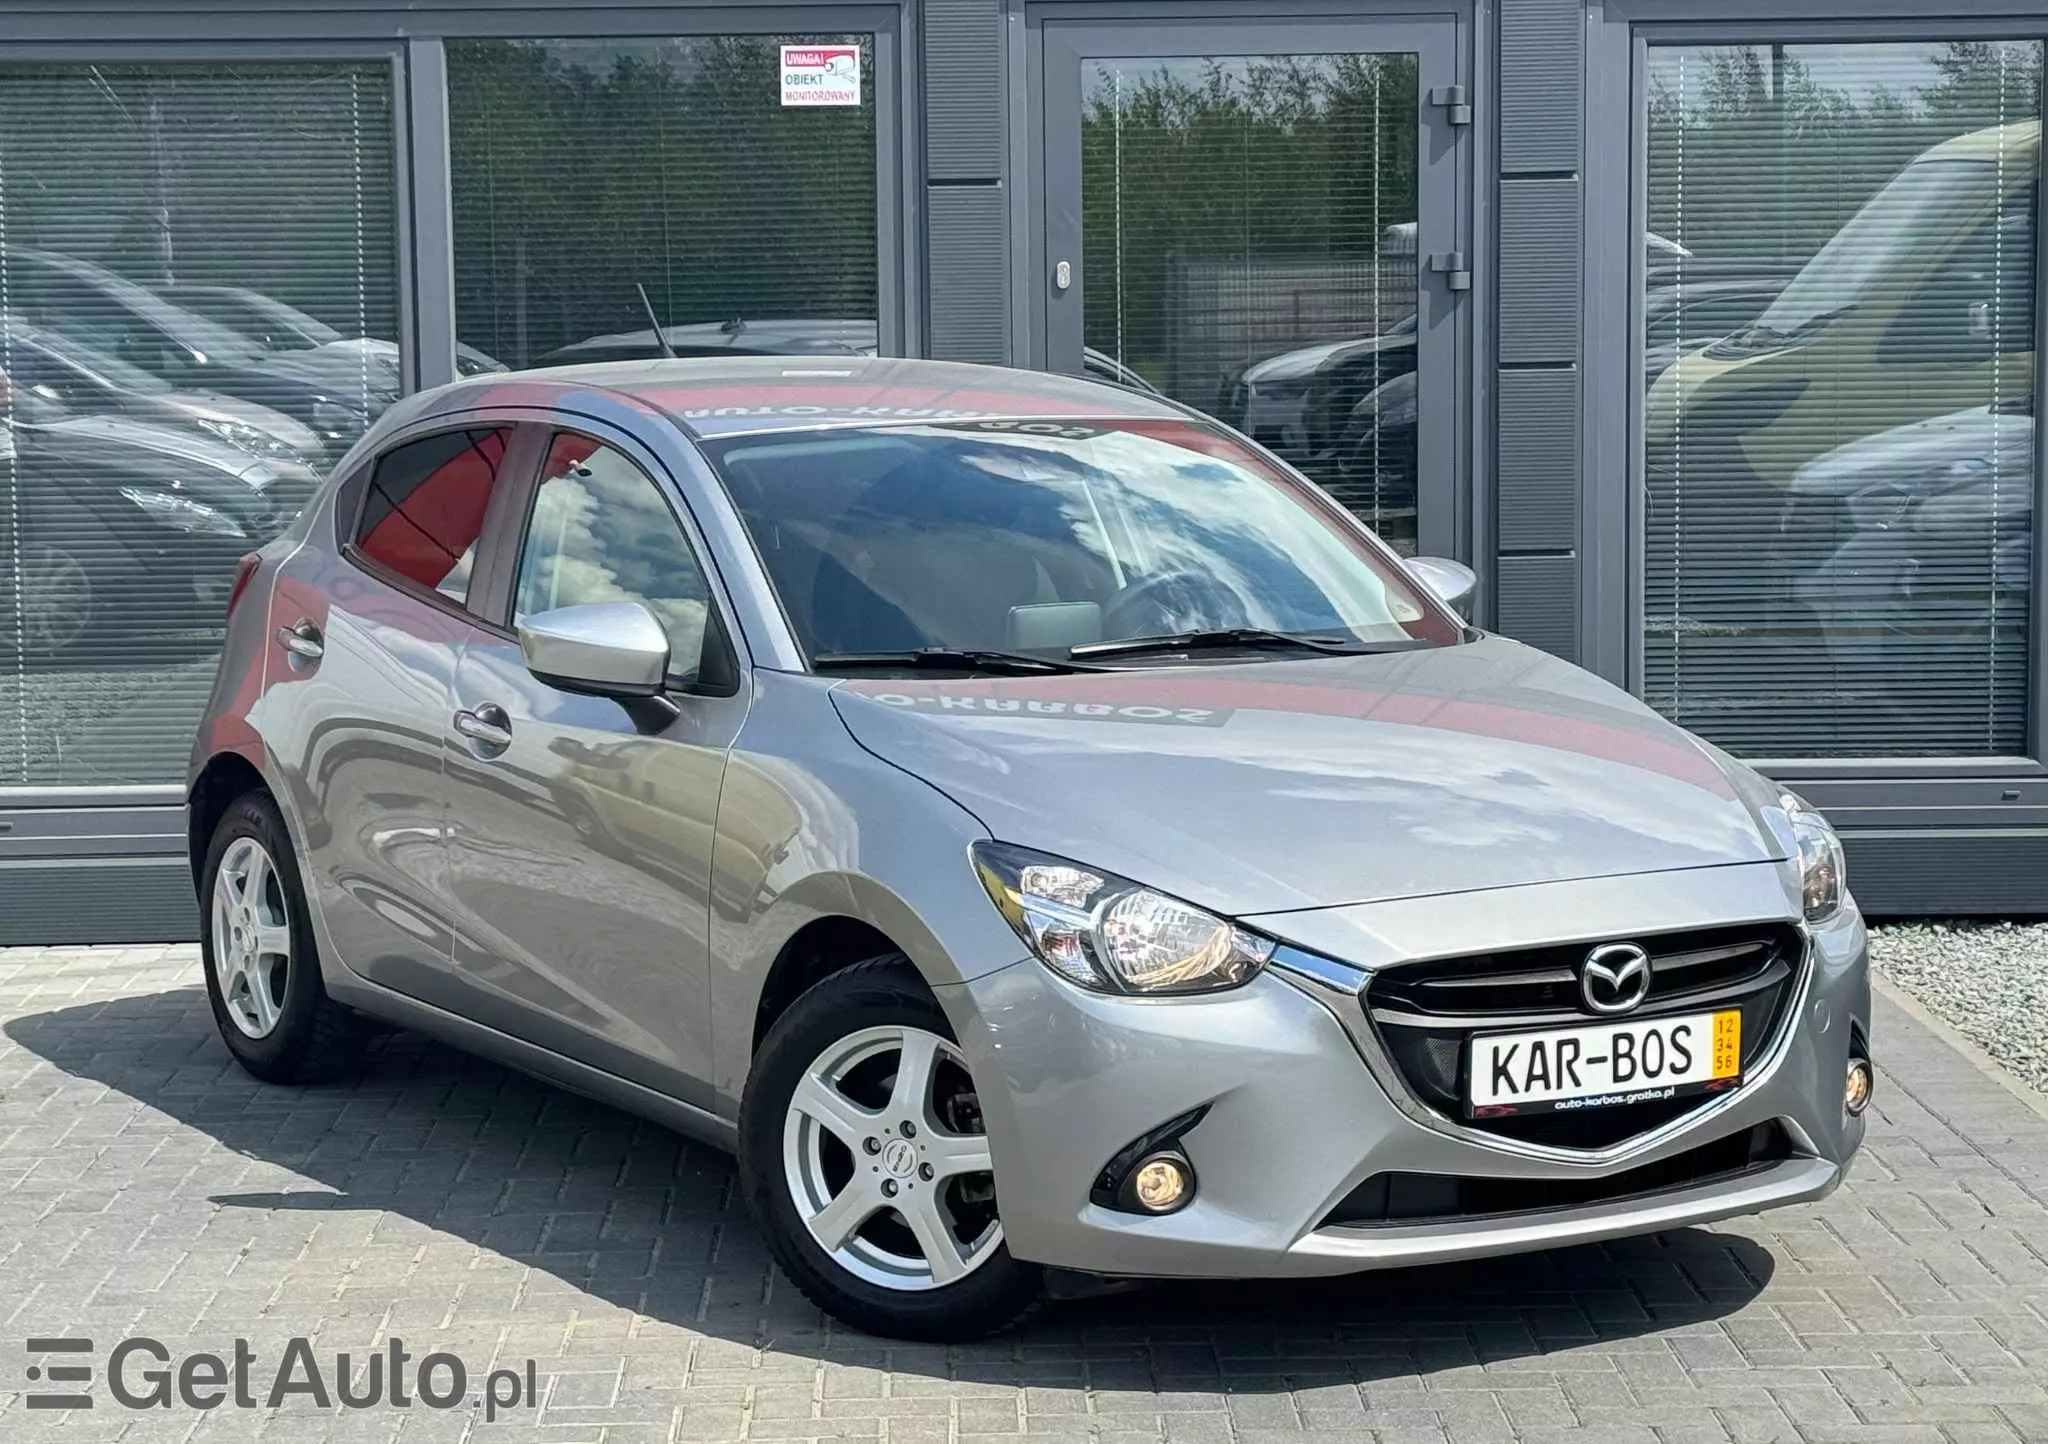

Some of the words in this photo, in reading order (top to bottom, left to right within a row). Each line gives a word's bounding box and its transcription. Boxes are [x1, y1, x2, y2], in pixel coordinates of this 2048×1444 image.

[786, 52, 825, 65] UWAGA!
[785, 73, 823, 85] OBIEKT
[785, 90, 855, 101] MONITOROWANY
[1719, 1018, 1734, 1033] 12
[1491, 1024, 1692, 1097] KAR-BOS
[1716, 1054, 1733, 1070] 56
